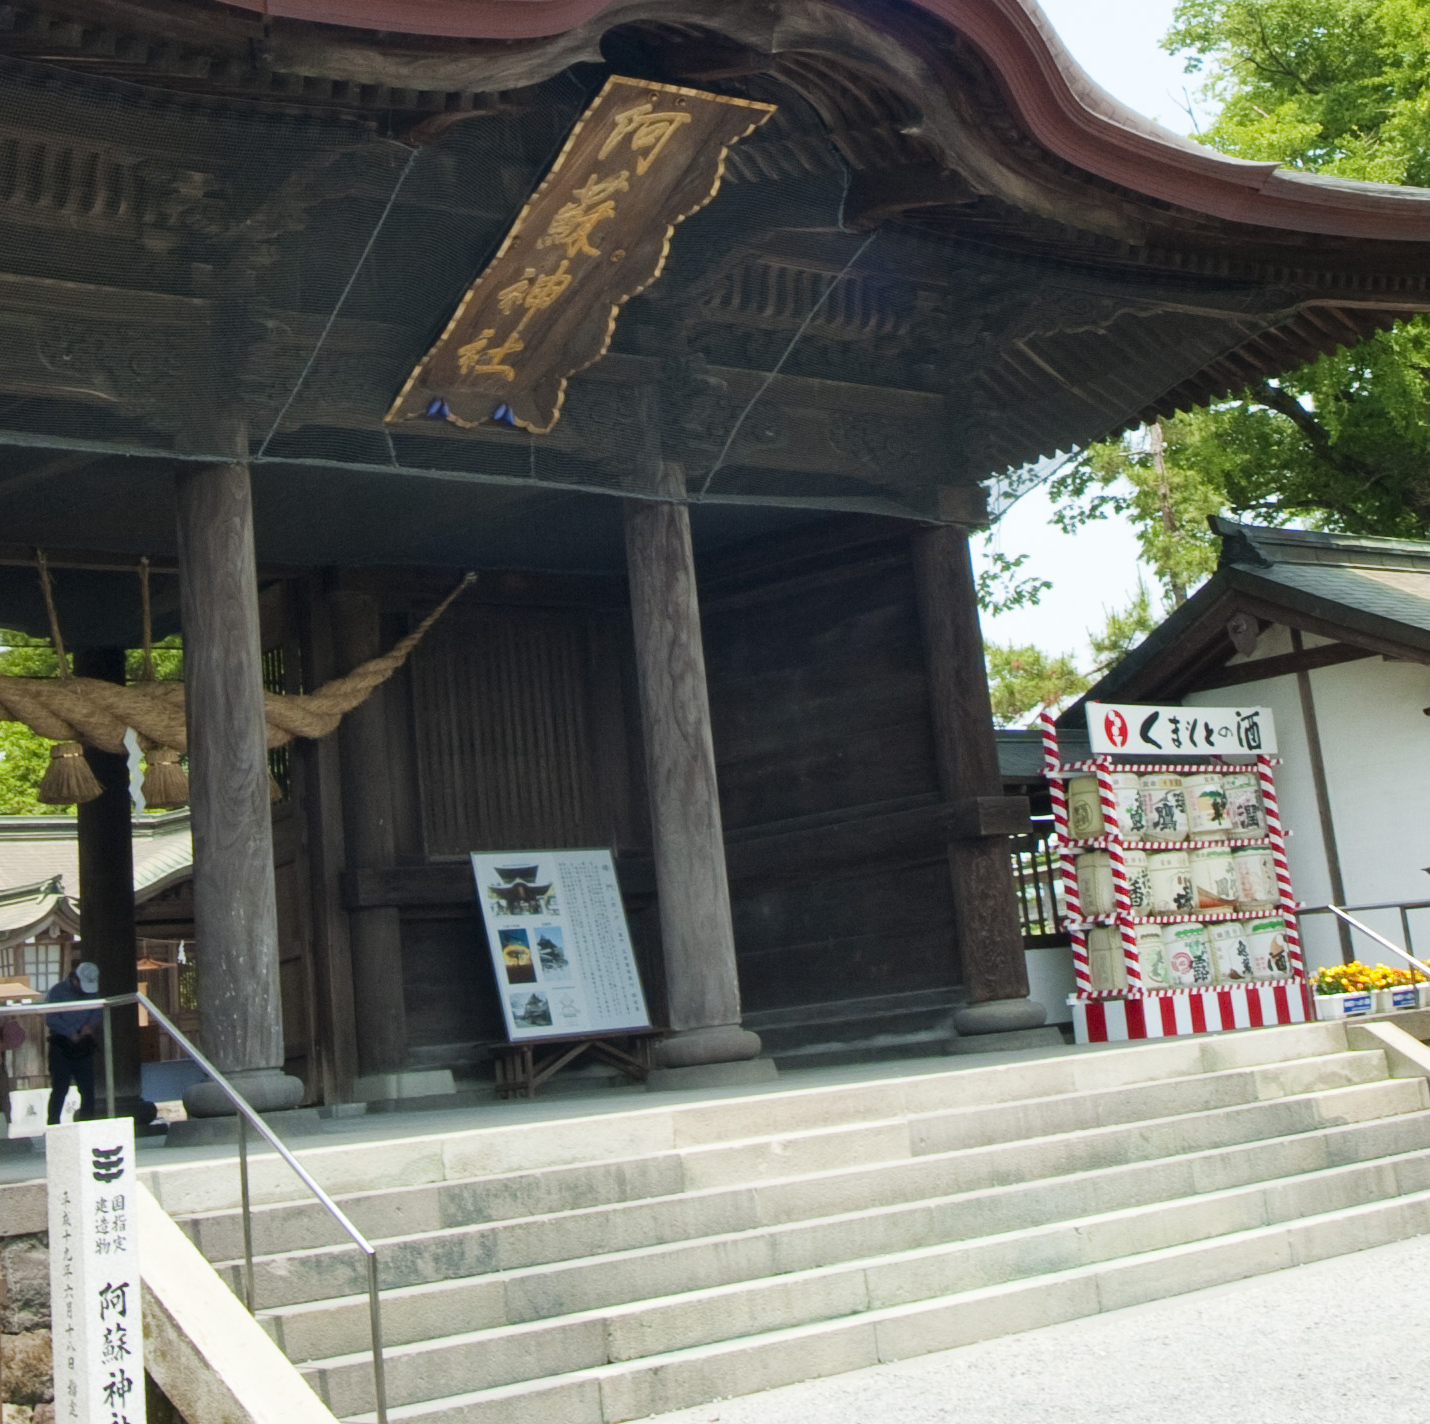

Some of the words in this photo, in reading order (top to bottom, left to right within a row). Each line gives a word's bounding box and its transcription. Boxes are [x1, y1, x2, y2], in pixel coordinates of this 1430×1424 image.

[1139, 711, 1262, 751] くまもとの酒
